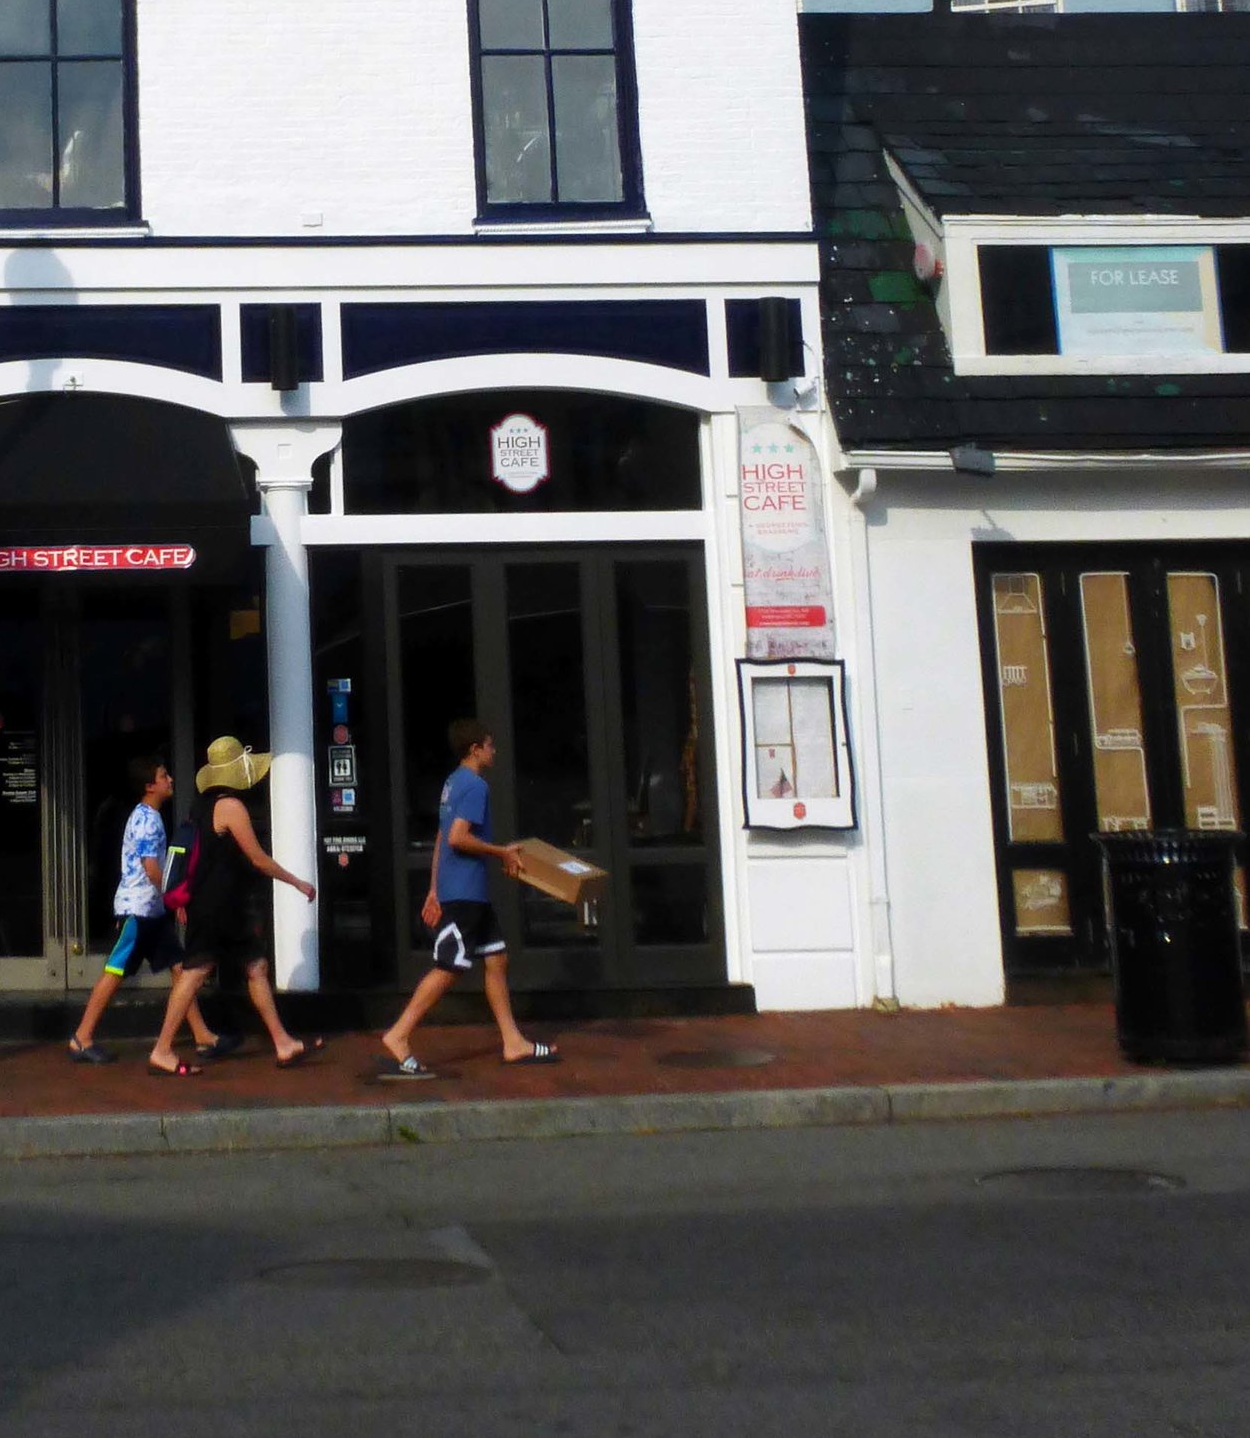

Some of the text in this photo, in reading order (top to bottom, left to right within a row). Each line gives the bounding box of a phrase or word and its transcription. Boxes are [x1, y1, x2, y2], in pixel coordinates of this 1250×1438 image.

[1090, 269, 1179, 286] FOR LEASE
[497, 436, 541, 449] HIGH
[500, 448, 538, 457] STREET
[500, 457, 540, 468] CAFE
[742, 463, 803, 480] HIGH
[743, 481, 806, 493] STREET
[743, 494, 806, 511] CAFE
[33, 548, 122, 566] STREET
[125, 547, 189, 566] CAFE
